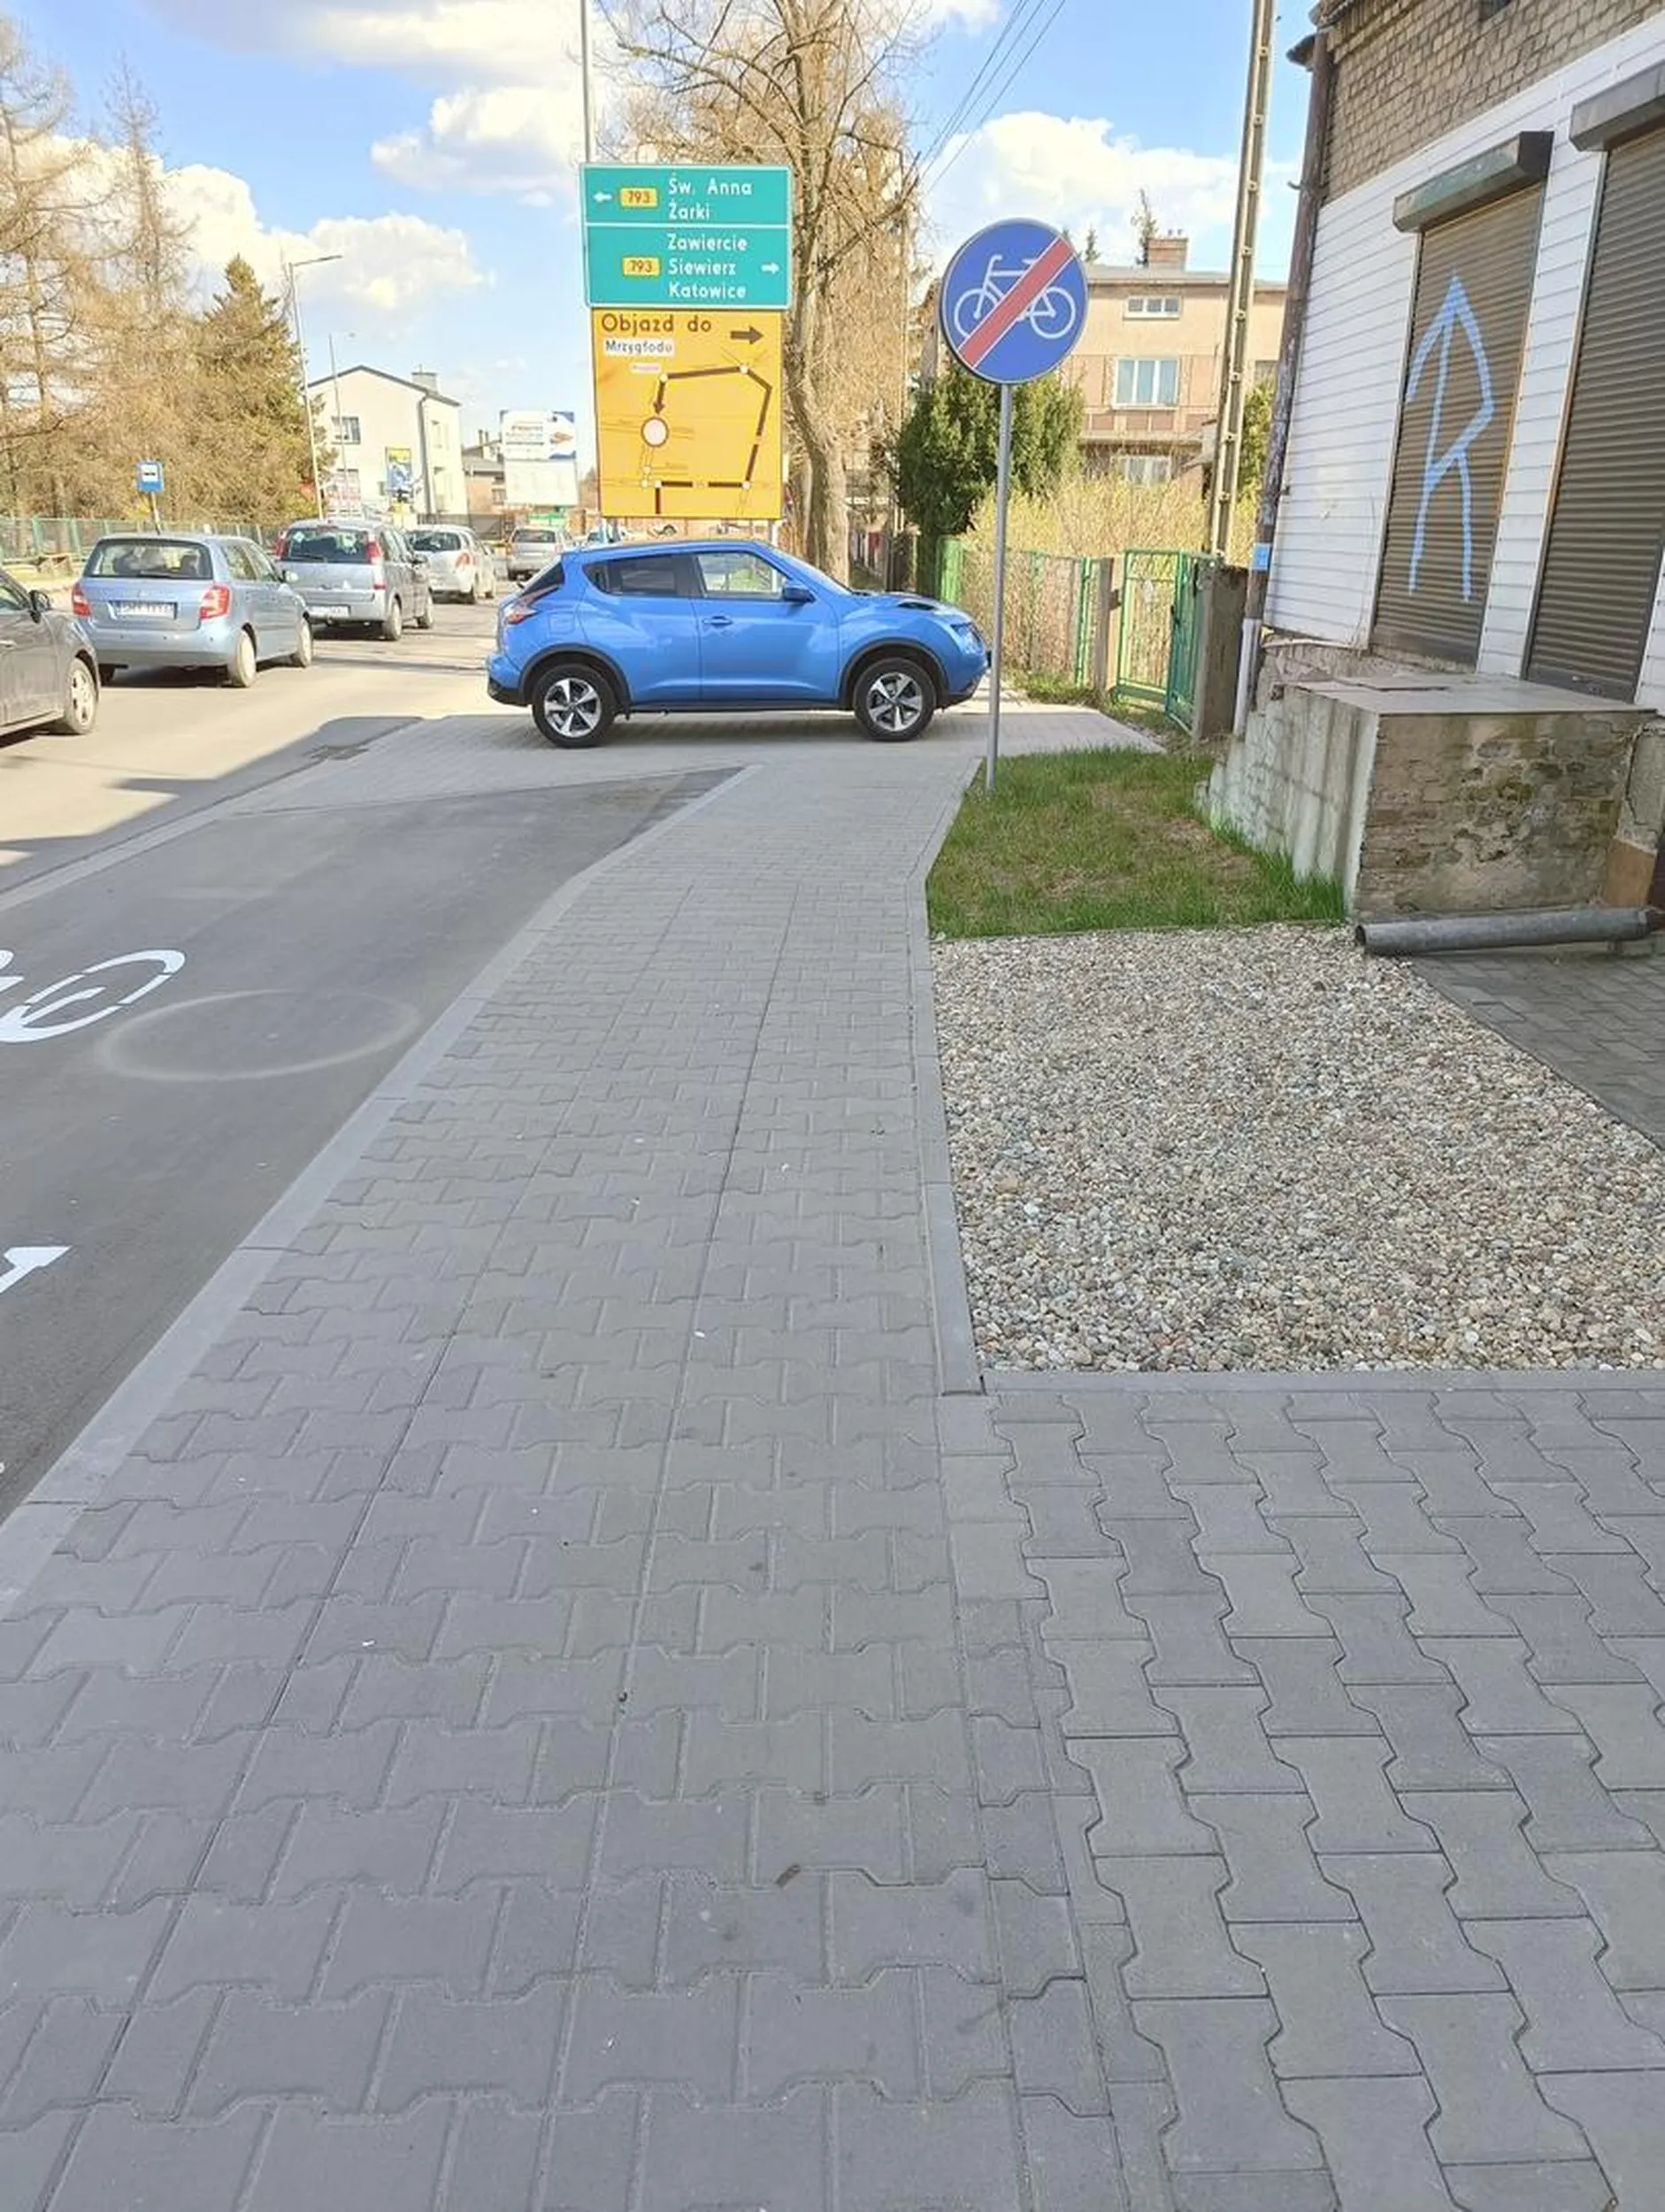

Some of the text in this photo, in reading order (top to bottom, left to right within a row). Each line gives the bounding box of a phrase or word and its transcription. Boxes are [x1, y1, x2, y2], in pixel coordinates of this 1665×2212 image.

[668, 172, 752, 196] Św. Anna
[627, 190, 651, 204] 793
[668, 198, 710, 219] Żarki
[667, 234, 748, 250] Zawiercie
[629, 259, 653, 273] 793
[668, 258, 737, 275] Siewierz
[669, 282, 747, 299] Katowice
[602, 313, 712, 336] Objazd do
